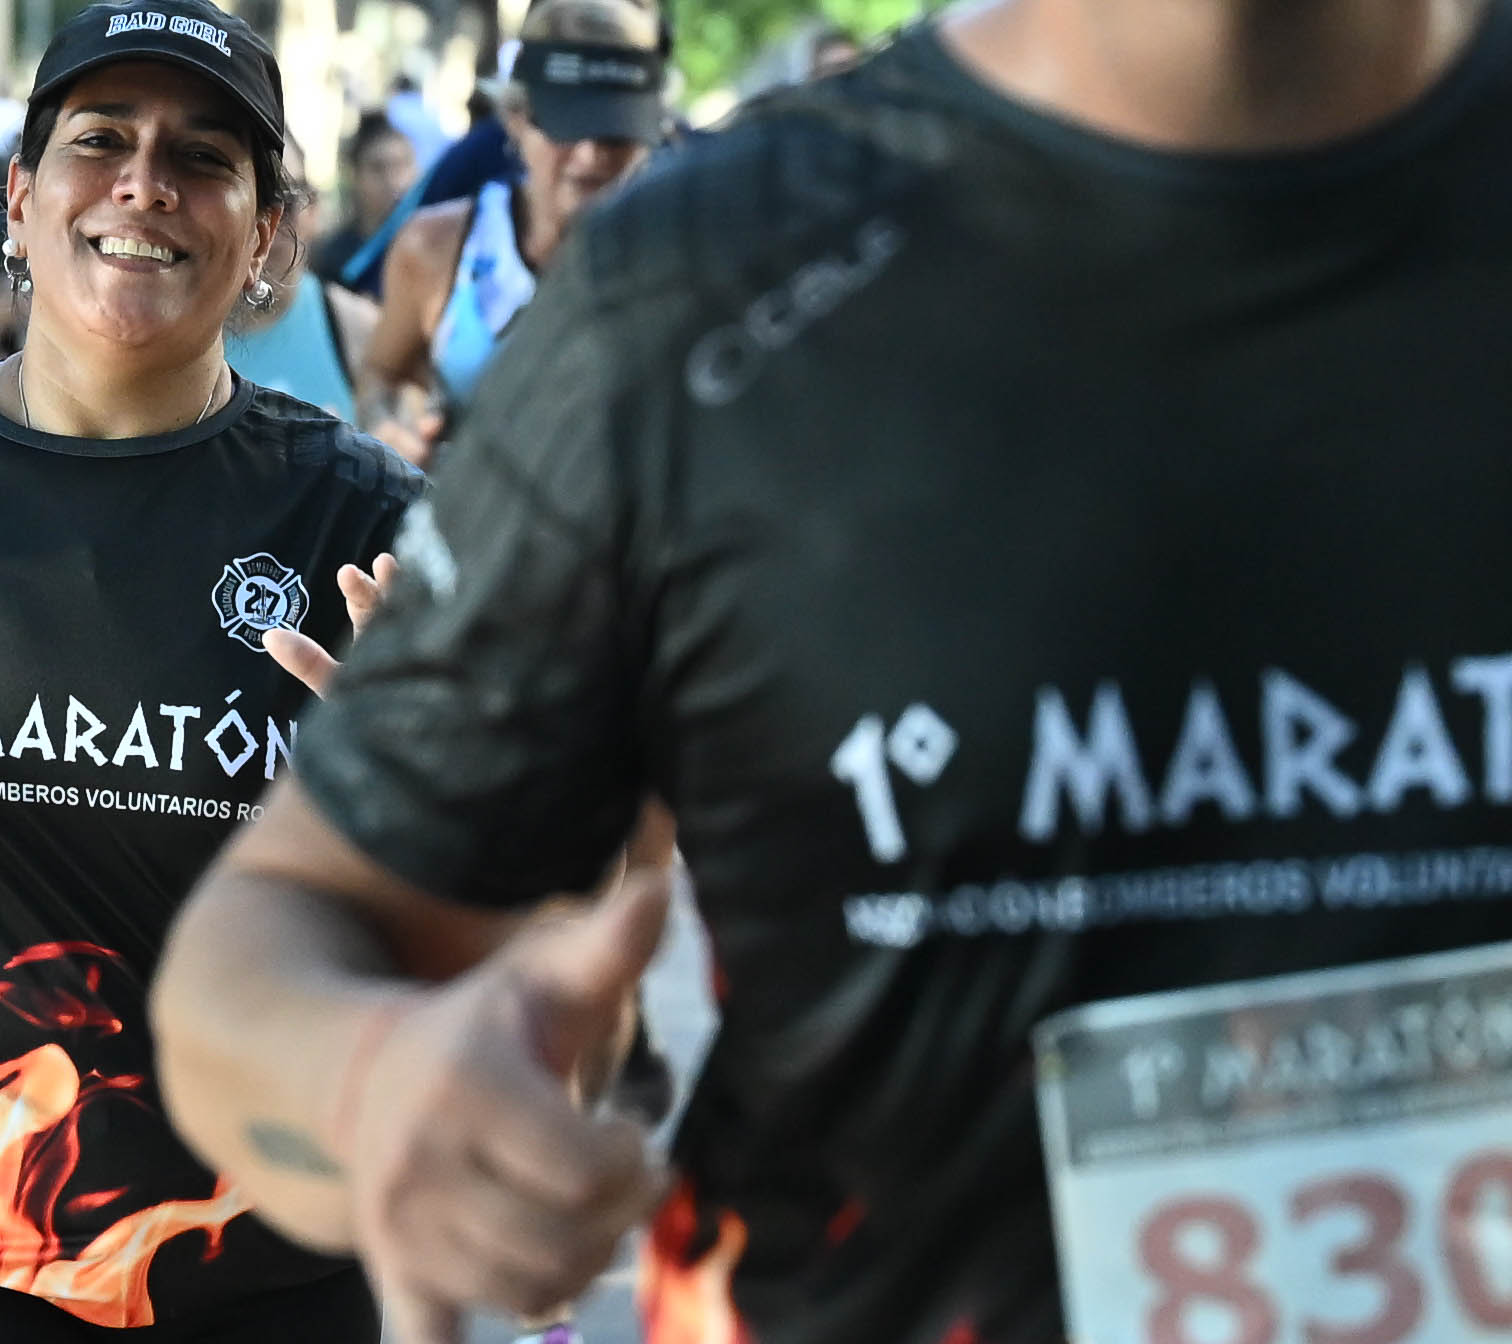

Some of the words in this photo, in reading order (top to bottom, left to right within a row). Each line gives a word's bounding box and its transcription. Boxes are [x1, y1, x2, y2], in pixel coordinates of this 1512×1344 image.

[105, 12, 167, 38] BAD
[169, 15, 232, 58] GIRL
[244, 582, 281, 616] 27
[85, 787, 232, 822] VOLUNTARIOS
